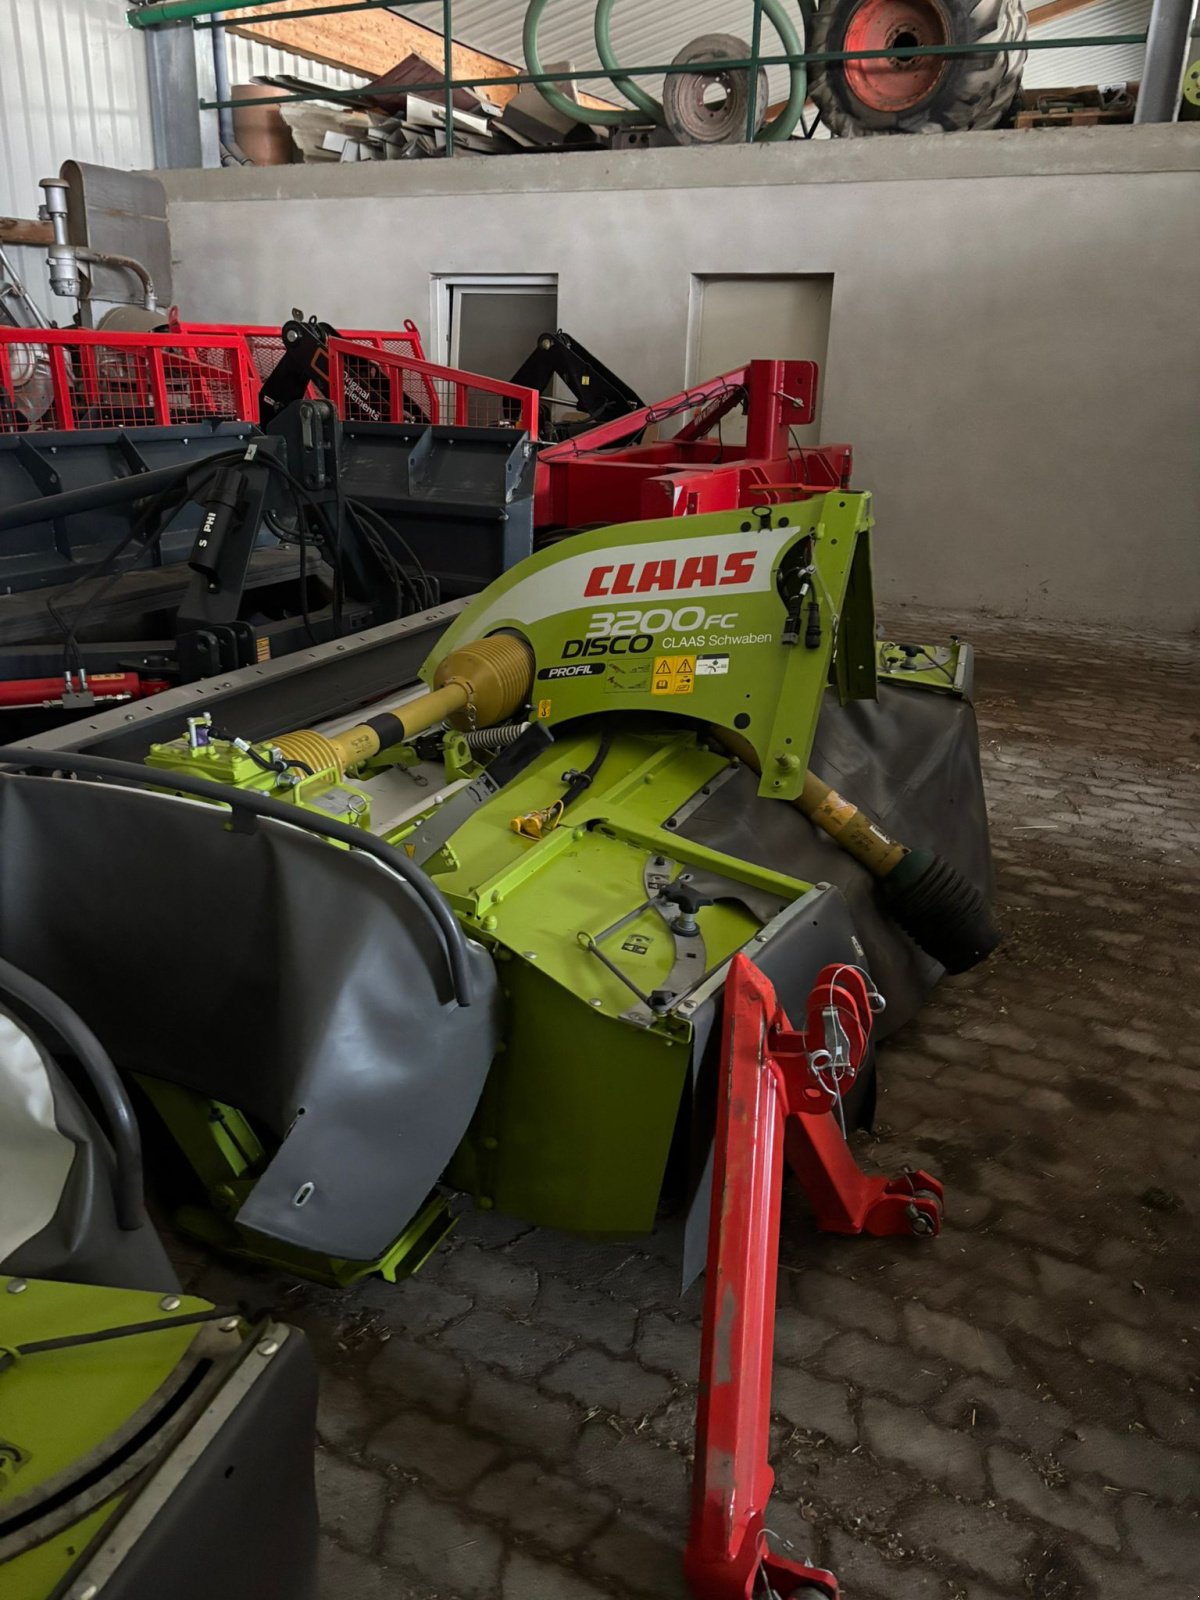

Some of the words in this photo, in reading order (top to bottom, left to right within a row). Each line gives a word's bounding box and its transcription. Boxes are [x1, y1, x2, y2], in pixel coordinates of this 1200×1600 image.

[583, 551, 758, 597] CLAAS
[561, 634, 654, 659] DISCO
[662, 635, 706, 649] CLAAS
[709, 632, 772, 647] Schwaben
[548, 664, 593, 679] PROFIL
